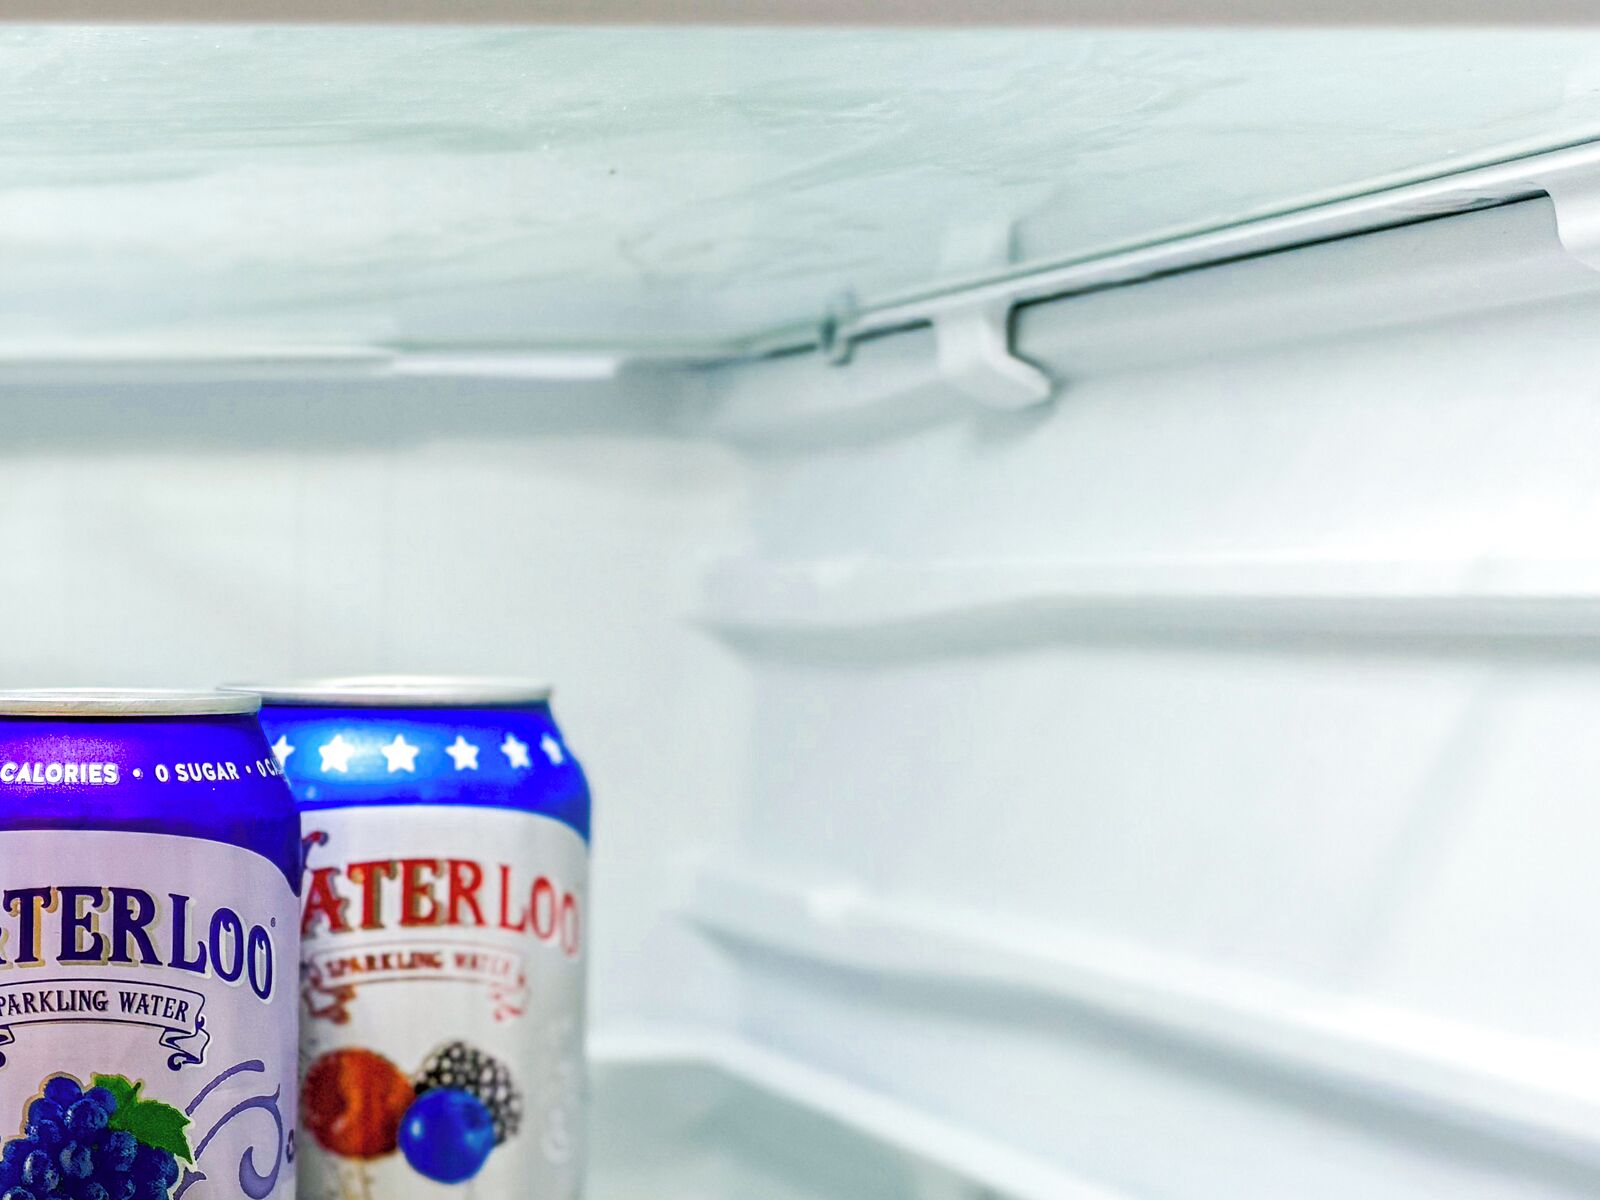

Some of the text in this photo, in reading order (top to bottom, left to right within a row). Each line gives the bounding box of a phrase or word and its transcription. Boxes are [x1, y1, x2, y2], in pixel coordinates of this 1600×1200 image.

[0, 762, 119, 786] CALORIES
[155, 764, 169, 783] 0
[175, 762, 240, 782] SUGAR
[256, 760, 267, 778] 0
[301, 831, 580, 957] ATERLOO
[118, 991, 190, 1023] WATER
